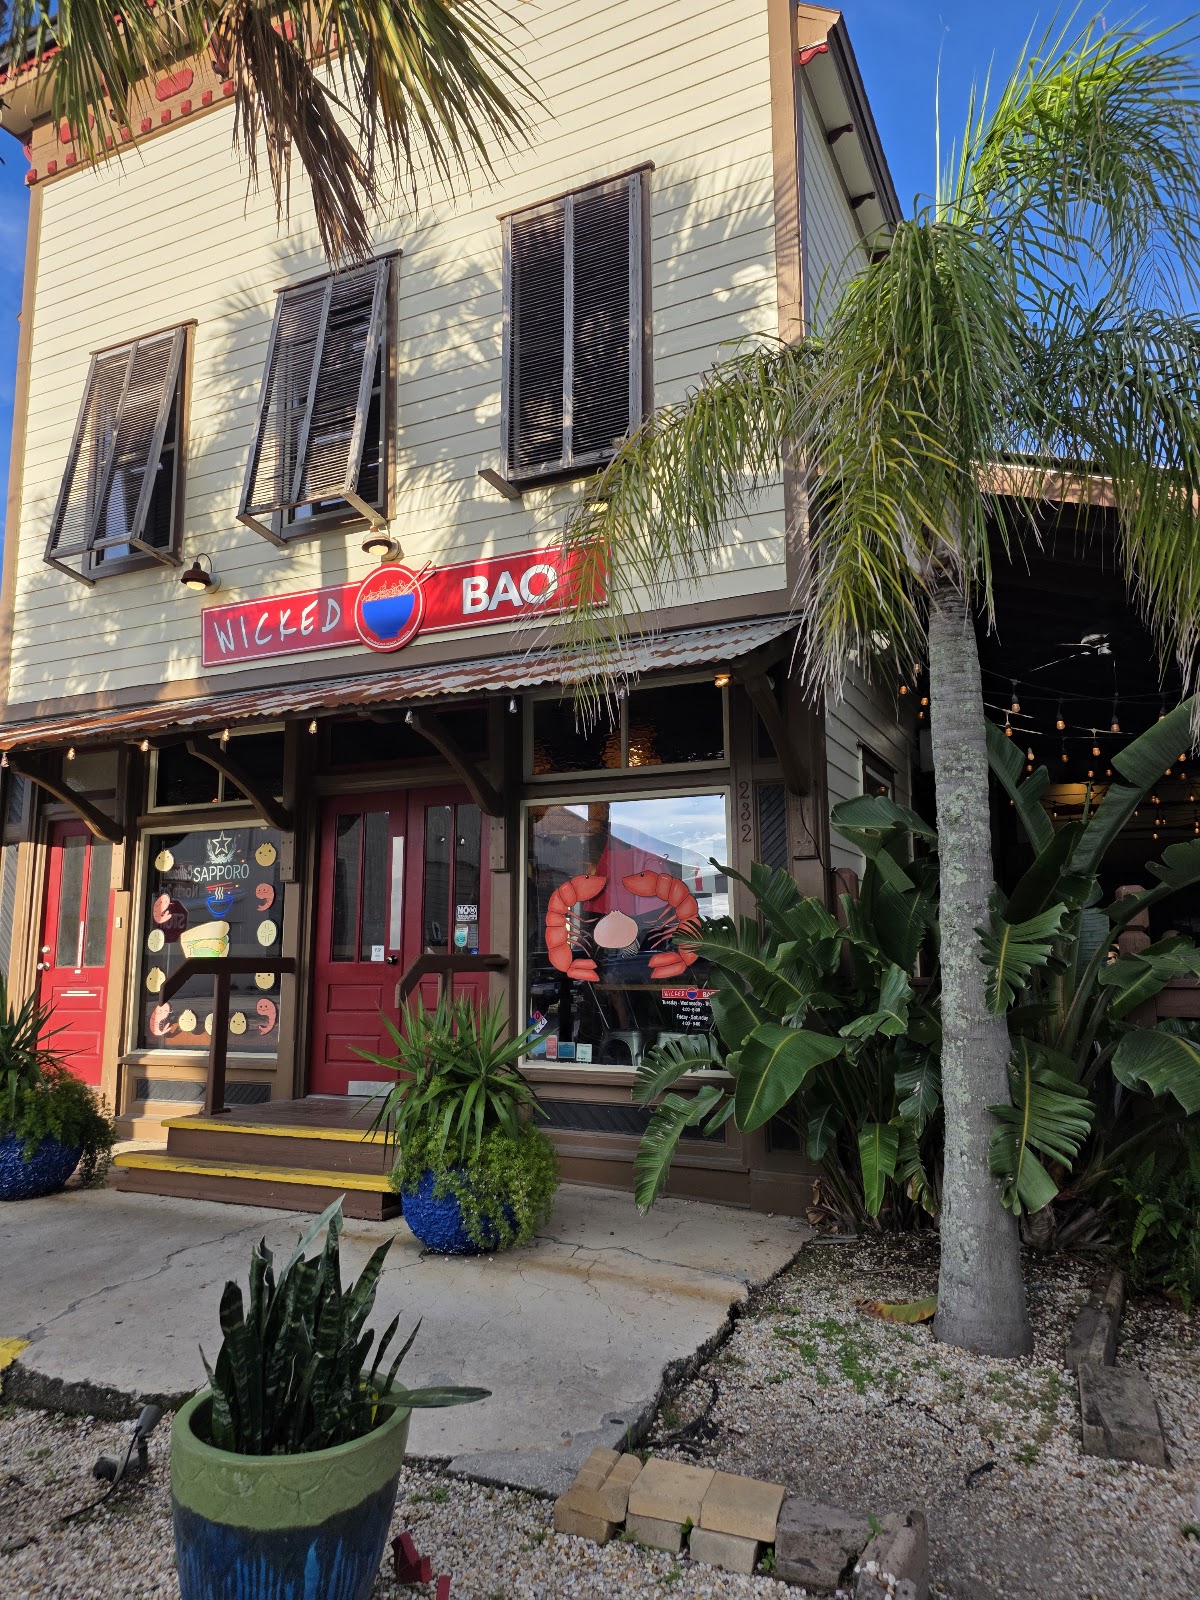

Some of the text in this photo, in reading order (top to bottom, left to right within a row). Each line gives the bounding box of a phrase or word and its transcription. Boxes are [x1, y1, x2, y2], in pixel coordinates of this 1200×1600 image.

[213, 564, 558, 654] WICKED BAO
[739, 781, 752, 843] 232
[193, 863, 250, 883] SAPPORO
